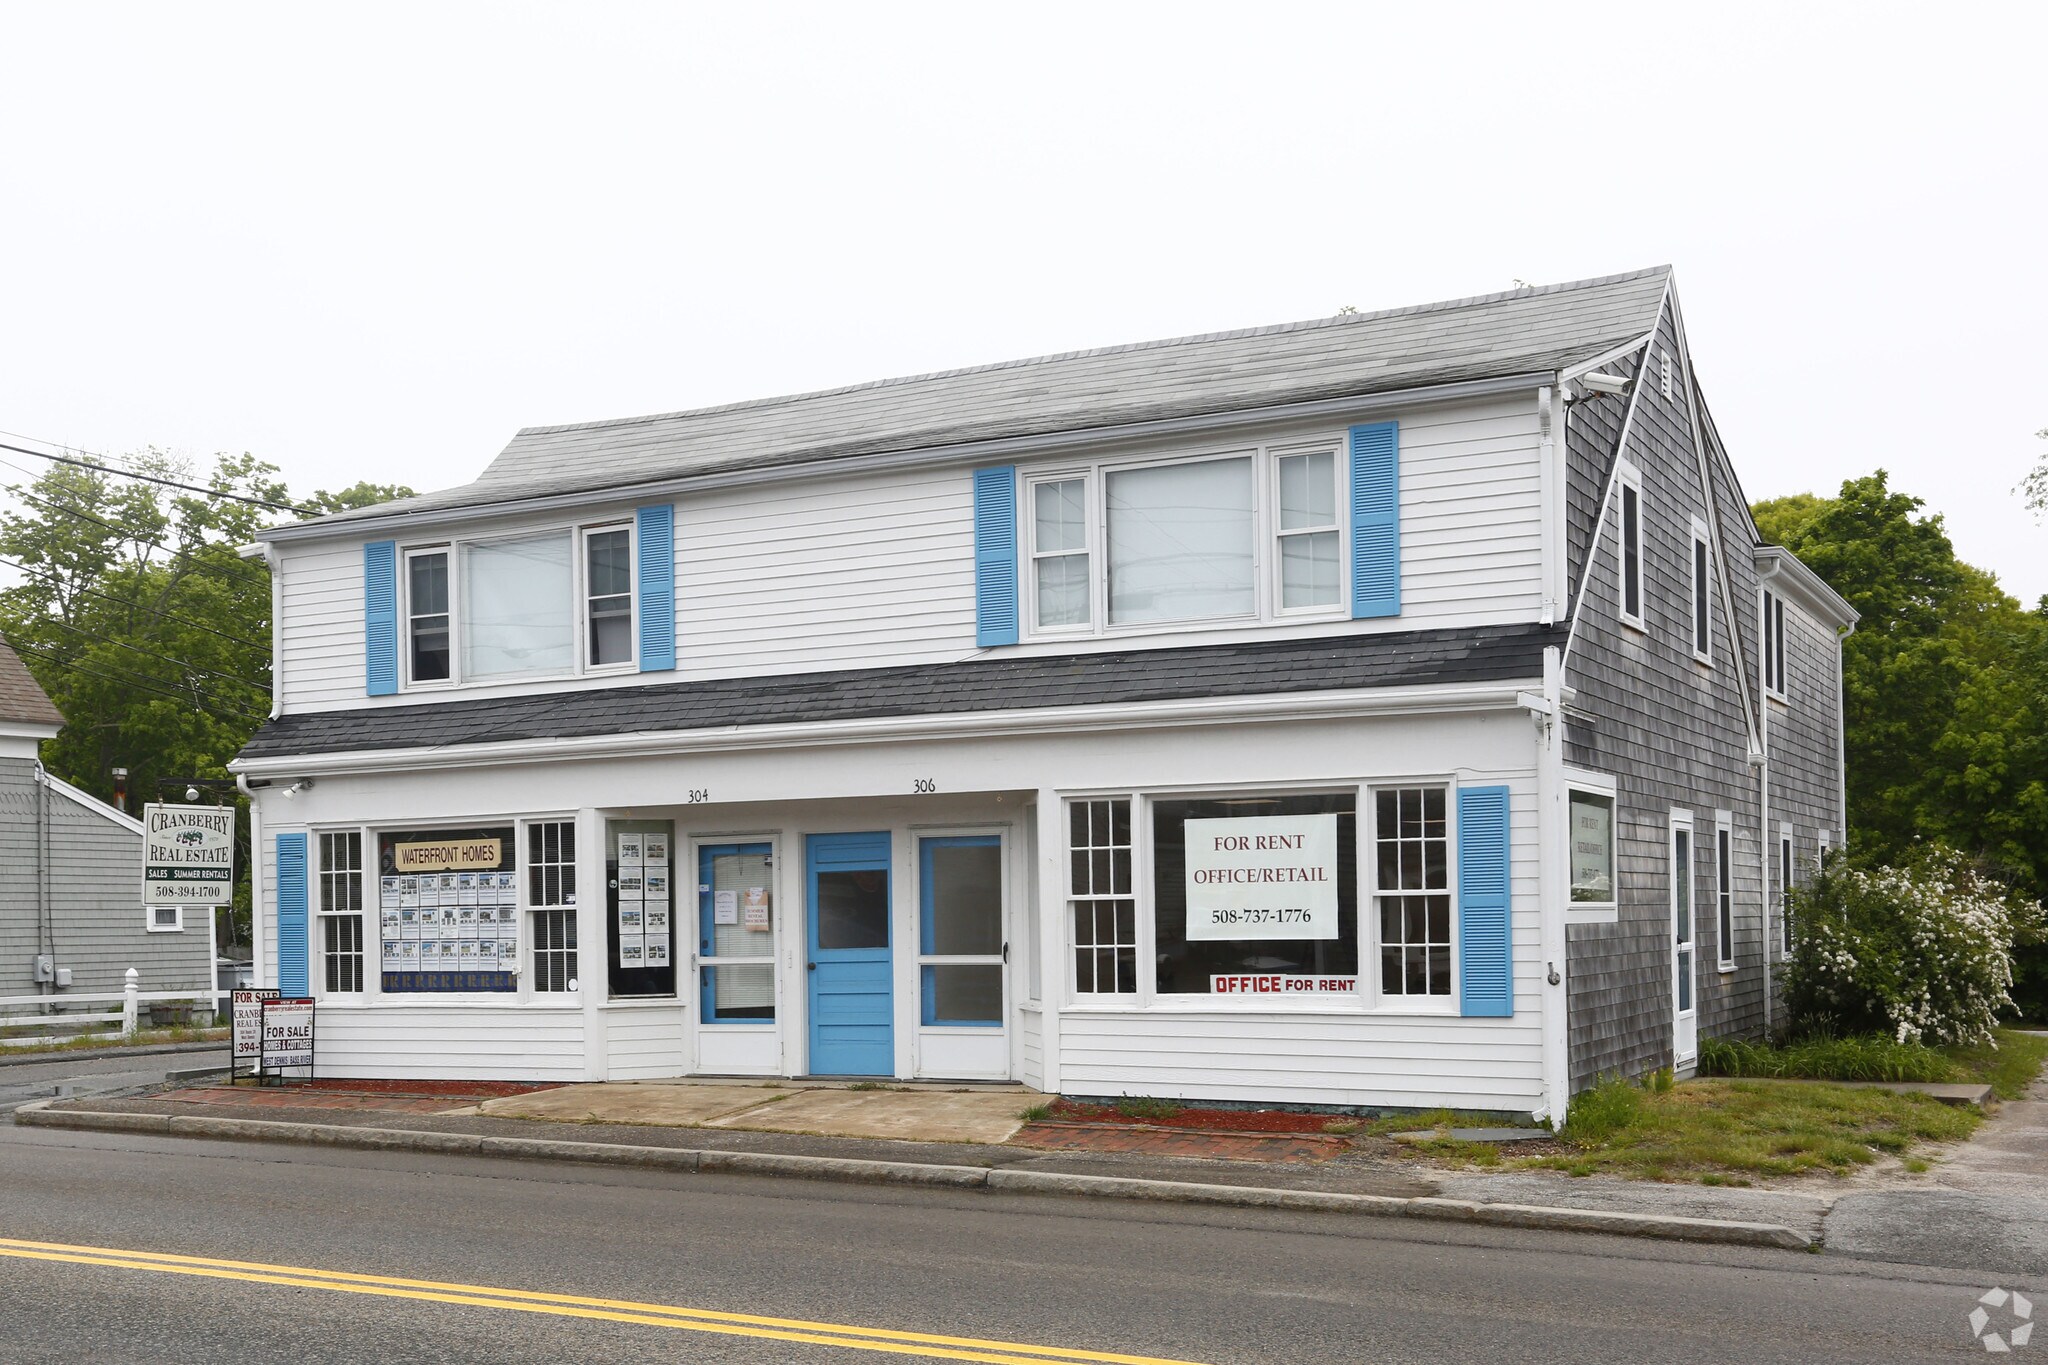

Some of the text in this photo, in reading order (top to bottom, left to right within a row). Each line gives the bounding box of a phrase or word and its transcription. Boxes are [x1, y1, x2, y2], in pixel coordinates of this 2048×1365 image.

[914, 778, 936, 793] 306
[688, 788, 708, 803] 304
[151, 812, 229, 836] CRANBERRY
[1214, 834, 1305, 851] FOR RENT
[150, 844, 229, 863] REAL ESTATE
[401, 844, 494, 864] WATERFRONT HOMES
[148, 869, 229, 879] SALES SUMMER RENTALS
[1194, 867, 1328, 884] OFFICE/RETAIL
[155, 885, 220, 897] 508-394-1700
[1211, 908, 1311, 924] 508-737-1776
[1215, 976, 1356, 993] OFFICE FOR RENT
[234, 992, 252, 1003] FOR
[234, 1009, 262, 1019] CRANB
[236, 1020, 254, 1028] REAL
[266, 1027, 285, 1038] FOR
[287, 1026, 309, 1037] SALE
[263, 1040, 281, 1050] HOMES
[286, 1039, 312, 1050] COTTAGES
[274, 1056, 288, 1065] DENNIS
[290, 1055, 300, 1064] BASS
[300, 1055, 311, 1064] RIVER
